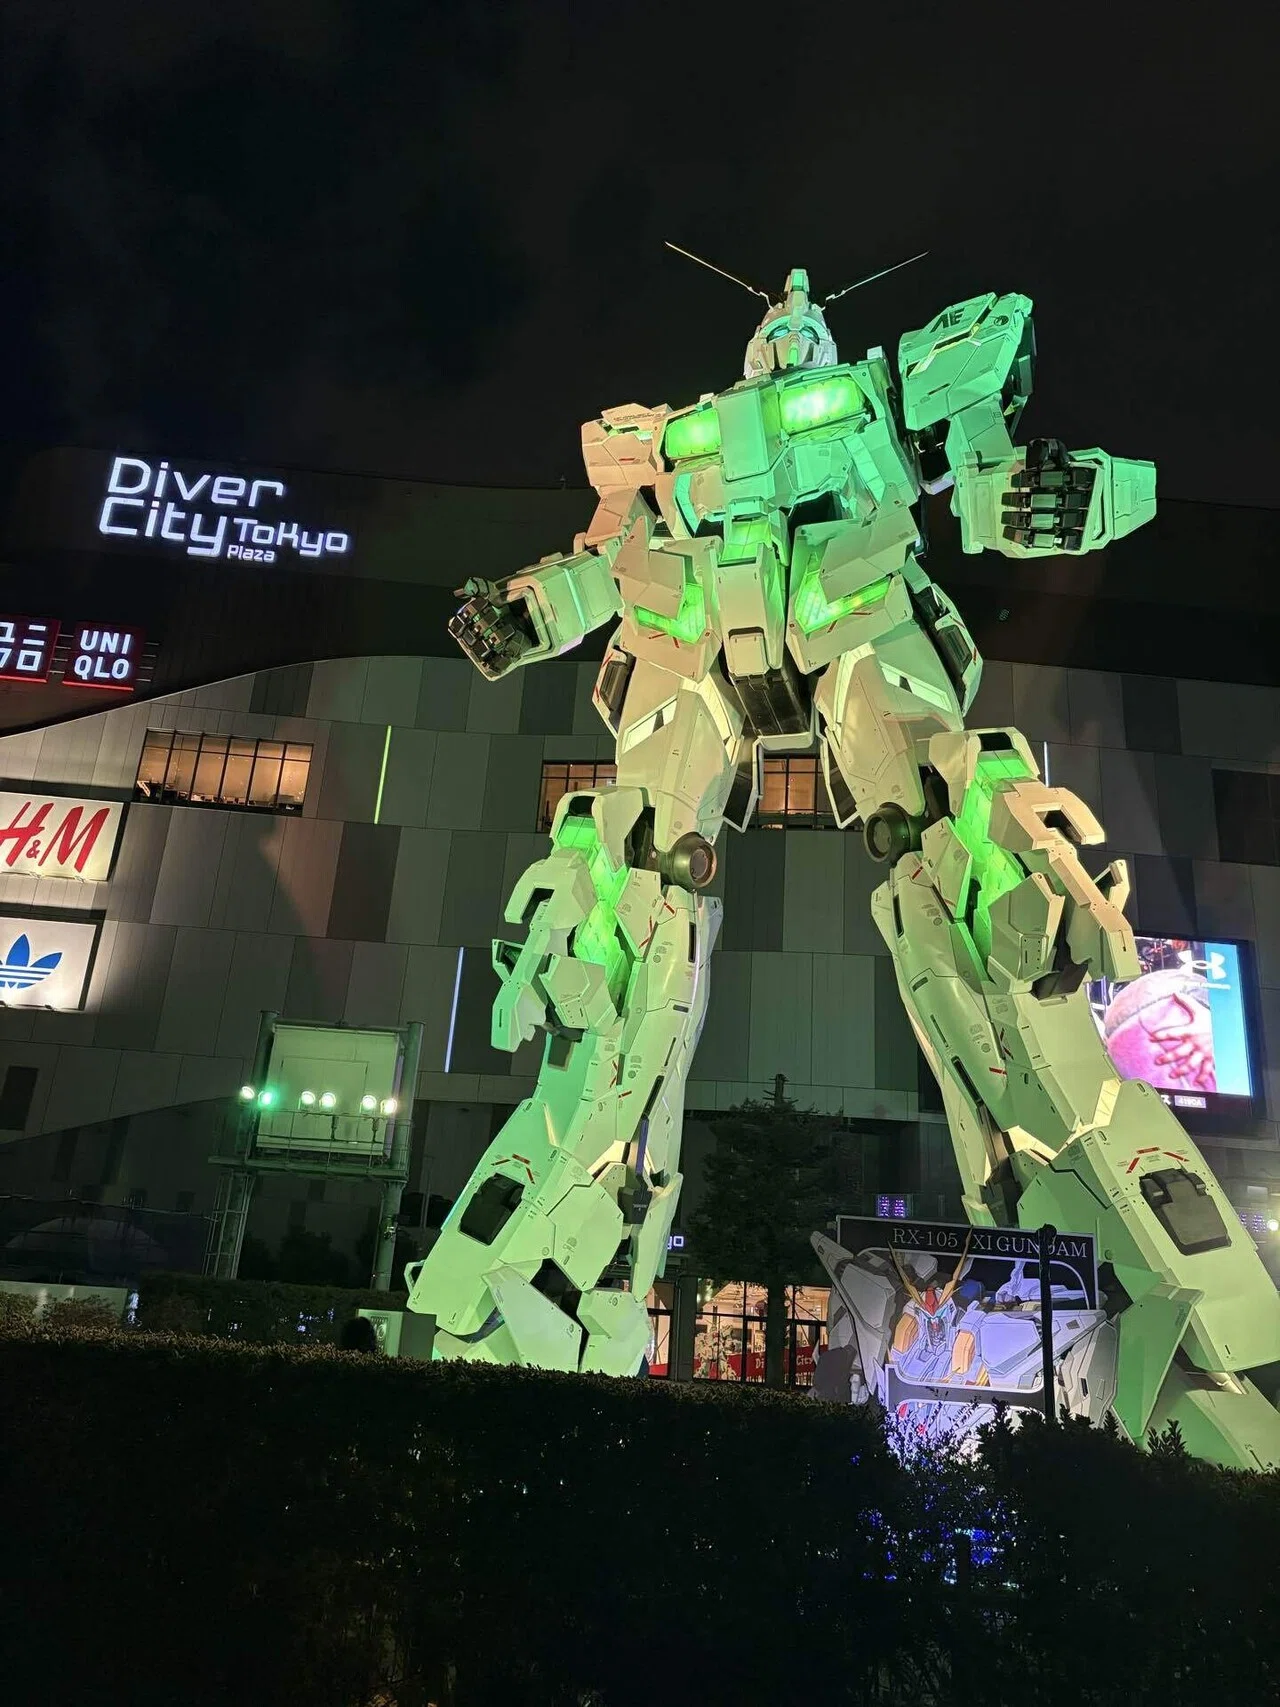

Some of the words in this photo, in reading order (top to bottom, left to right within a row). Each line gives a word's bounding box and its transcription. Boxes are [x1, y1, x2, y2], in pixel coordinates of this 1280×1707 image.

[107, 456, 285, 507] Diver
[99, 496, 227, 557] City
[227, 544, 276, 563] Plaza
[80, 629, 132, 655] UNI
[74, 655, 130, 680] QLO
[0, 801, 110, 873] H&M
[893, 1228, 958, 1248] RX-105
[972, 1233, 991, 1250] XI
